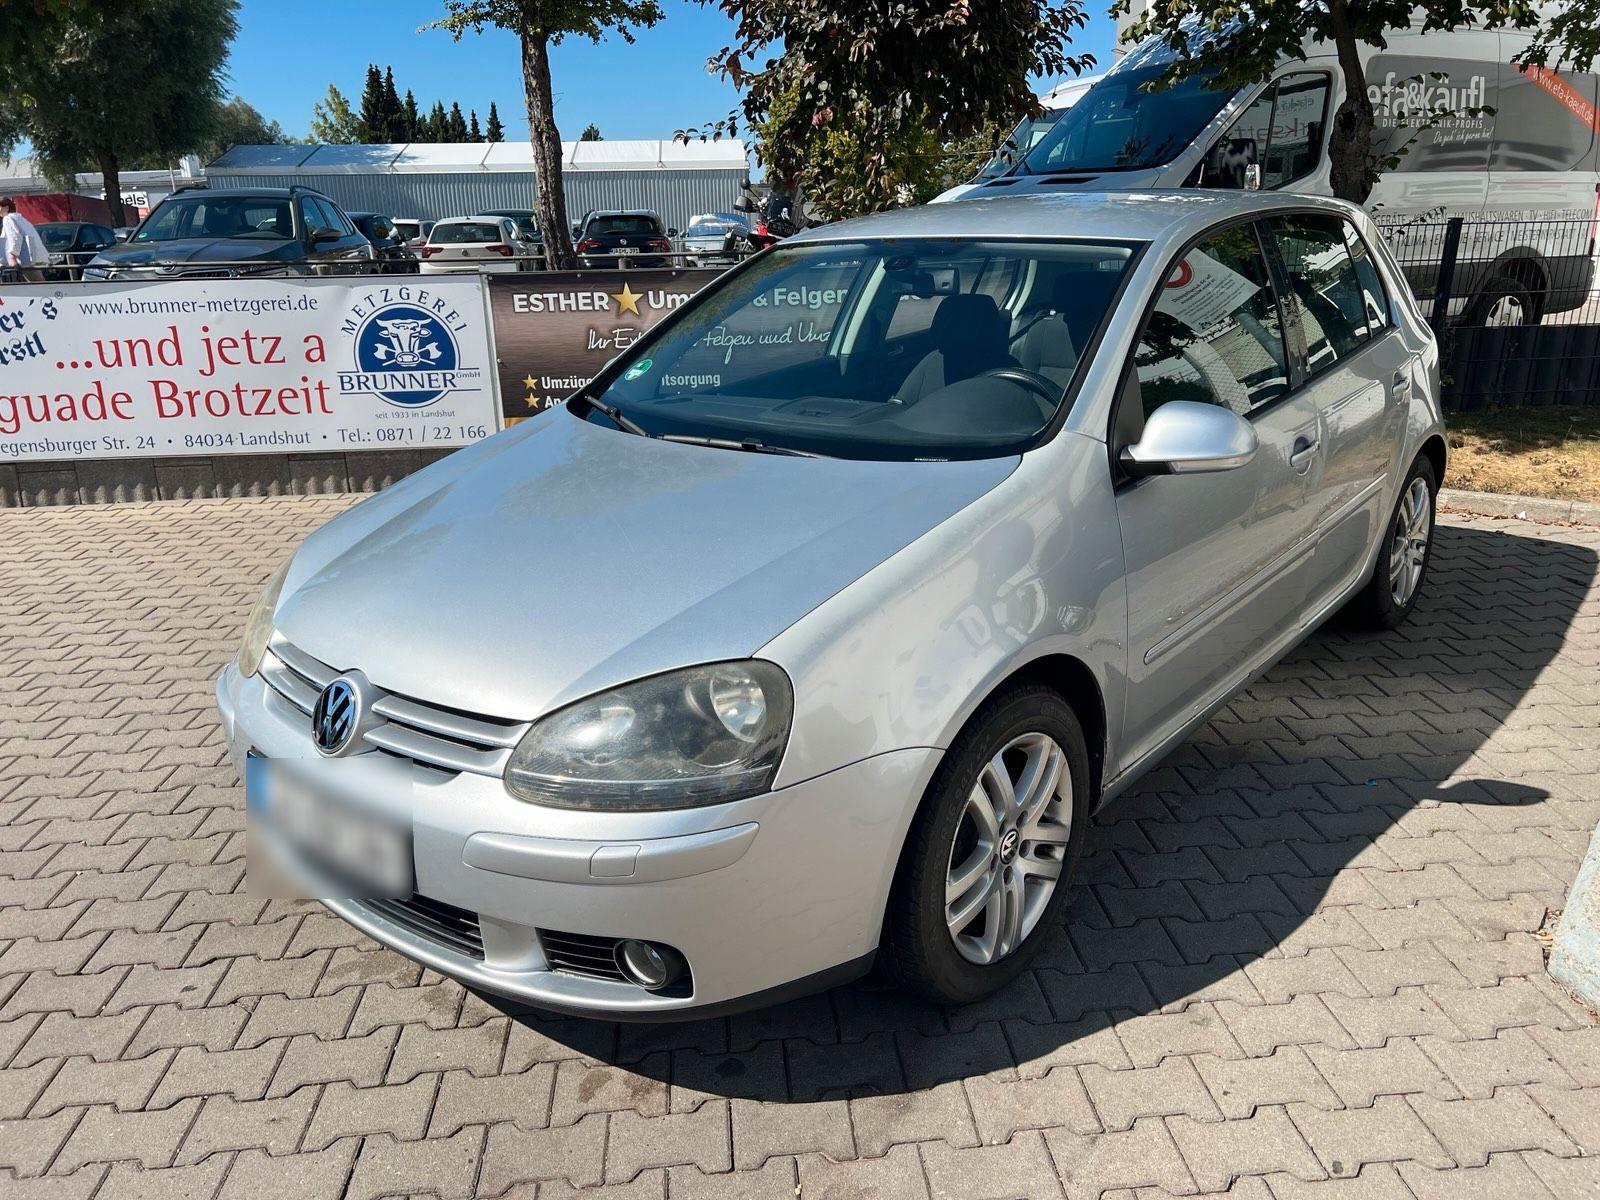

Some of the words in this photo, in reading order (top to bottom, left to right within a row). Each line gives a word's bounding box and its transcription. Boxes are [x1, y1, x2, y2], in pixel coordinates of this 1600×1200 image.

[1533, 67, 1594, 124] www.efa-kaeufl.de
[1382, 119, 1397, 128] DIE
[78, 294, 319, 316] www.brunner-metzgerei.de
[340, 286, 467, 336] METZGEREI
[513, 291, 610, 313] ESTHER
[587, 328, 613, 350] Ihr
[759, 326, 793, 345] und
[198, 325, 286, 377] jetz
[303, 334, 326, 363] a
[338, 372, 457, 392] BRUNNER
[456, 371, 481, 380] GmbH
[0, 380, 135, 435] guade
[147, 375, 334, 419] Brotzeit
[375, 411, 388, 420] seit
[391, 410, 409, 419] 1933
[411, 409, 420, 418] in
[421, 409, 455, 418] Landshut
[102, 436, 130, 451] Str.
[136, 435, 156, 449] 24
[185, 433, 234, 448] 84034
[240, 430, 311, 446] Landshut
[338, 428, 371, 443] Tel.:
[376, 427, 414, 442] 0871
[433, 426, 452, 440] 22
[459, 425, 487, 439] 166
